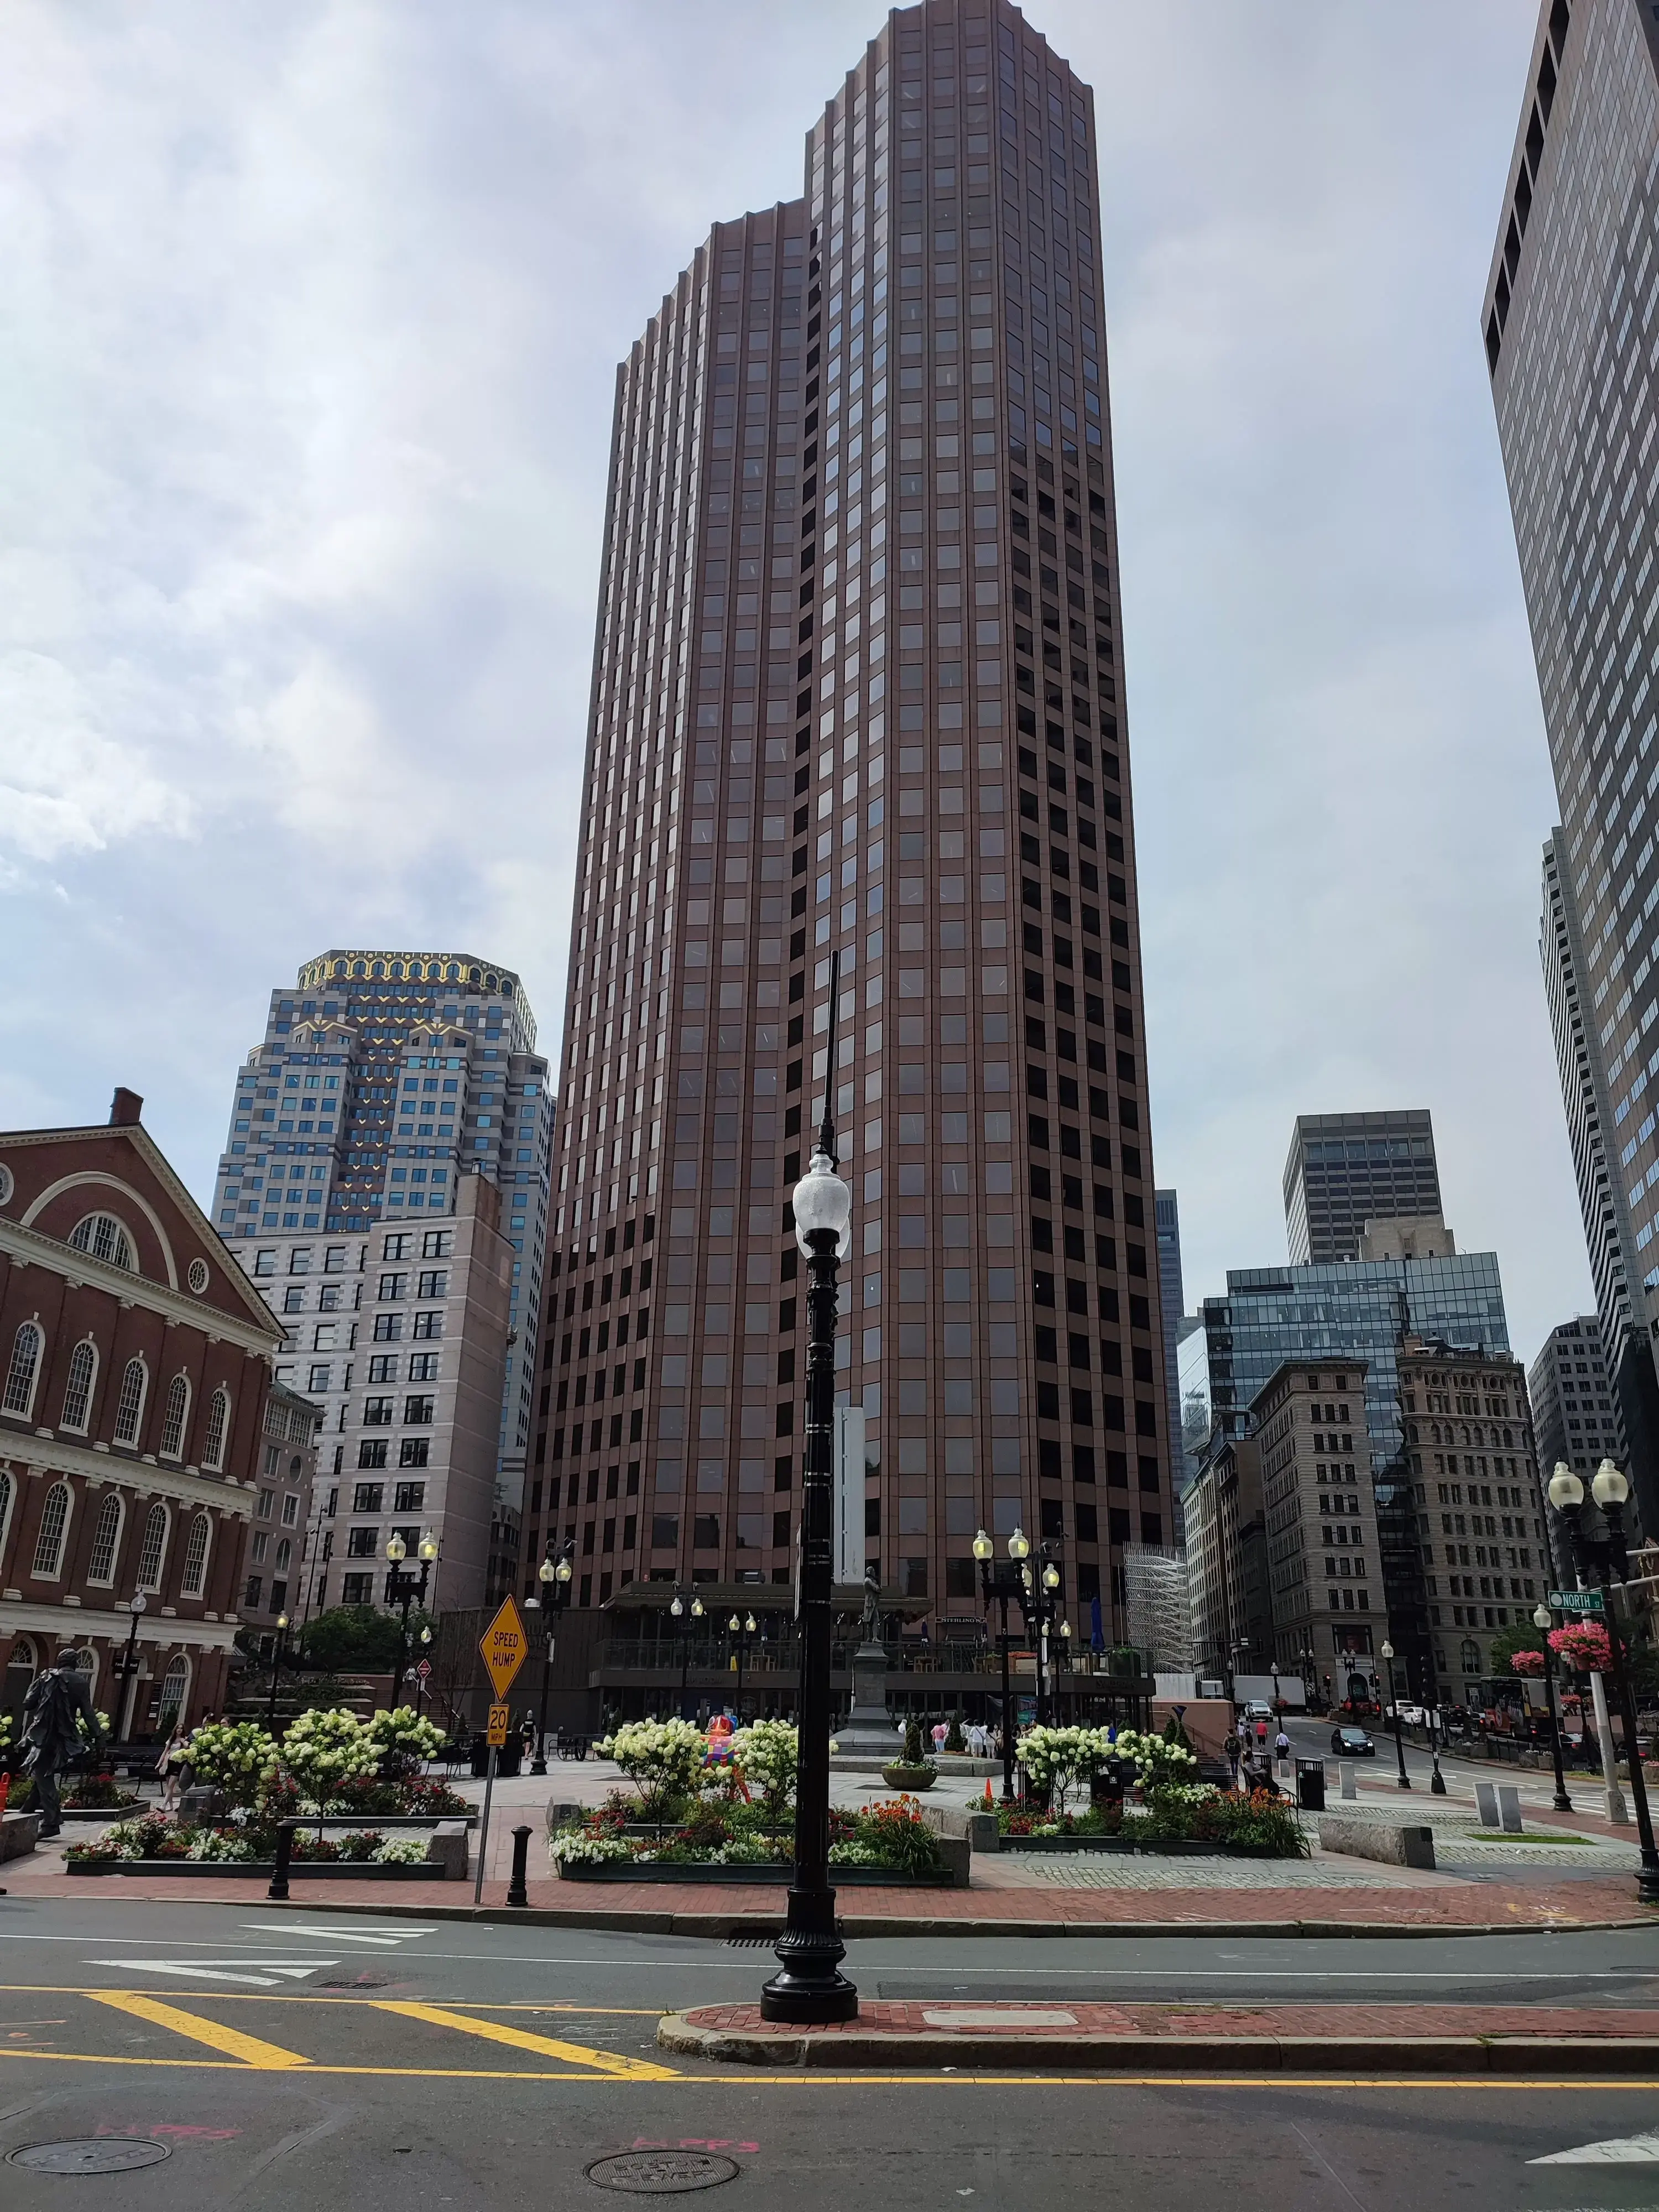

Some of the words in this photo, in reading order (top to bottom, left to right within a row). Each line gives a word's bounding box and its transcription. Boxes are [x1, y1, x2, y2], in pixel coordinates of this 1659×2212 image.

[1563, 1594, 1590, 1608] NORTH
[494, 1631, 518, 1648] SPEED
[492, 1651, 515, 1668] HUMP
[489, 1710, 505, 1729] 20
[491, 1733, 502, 1741] MPH
